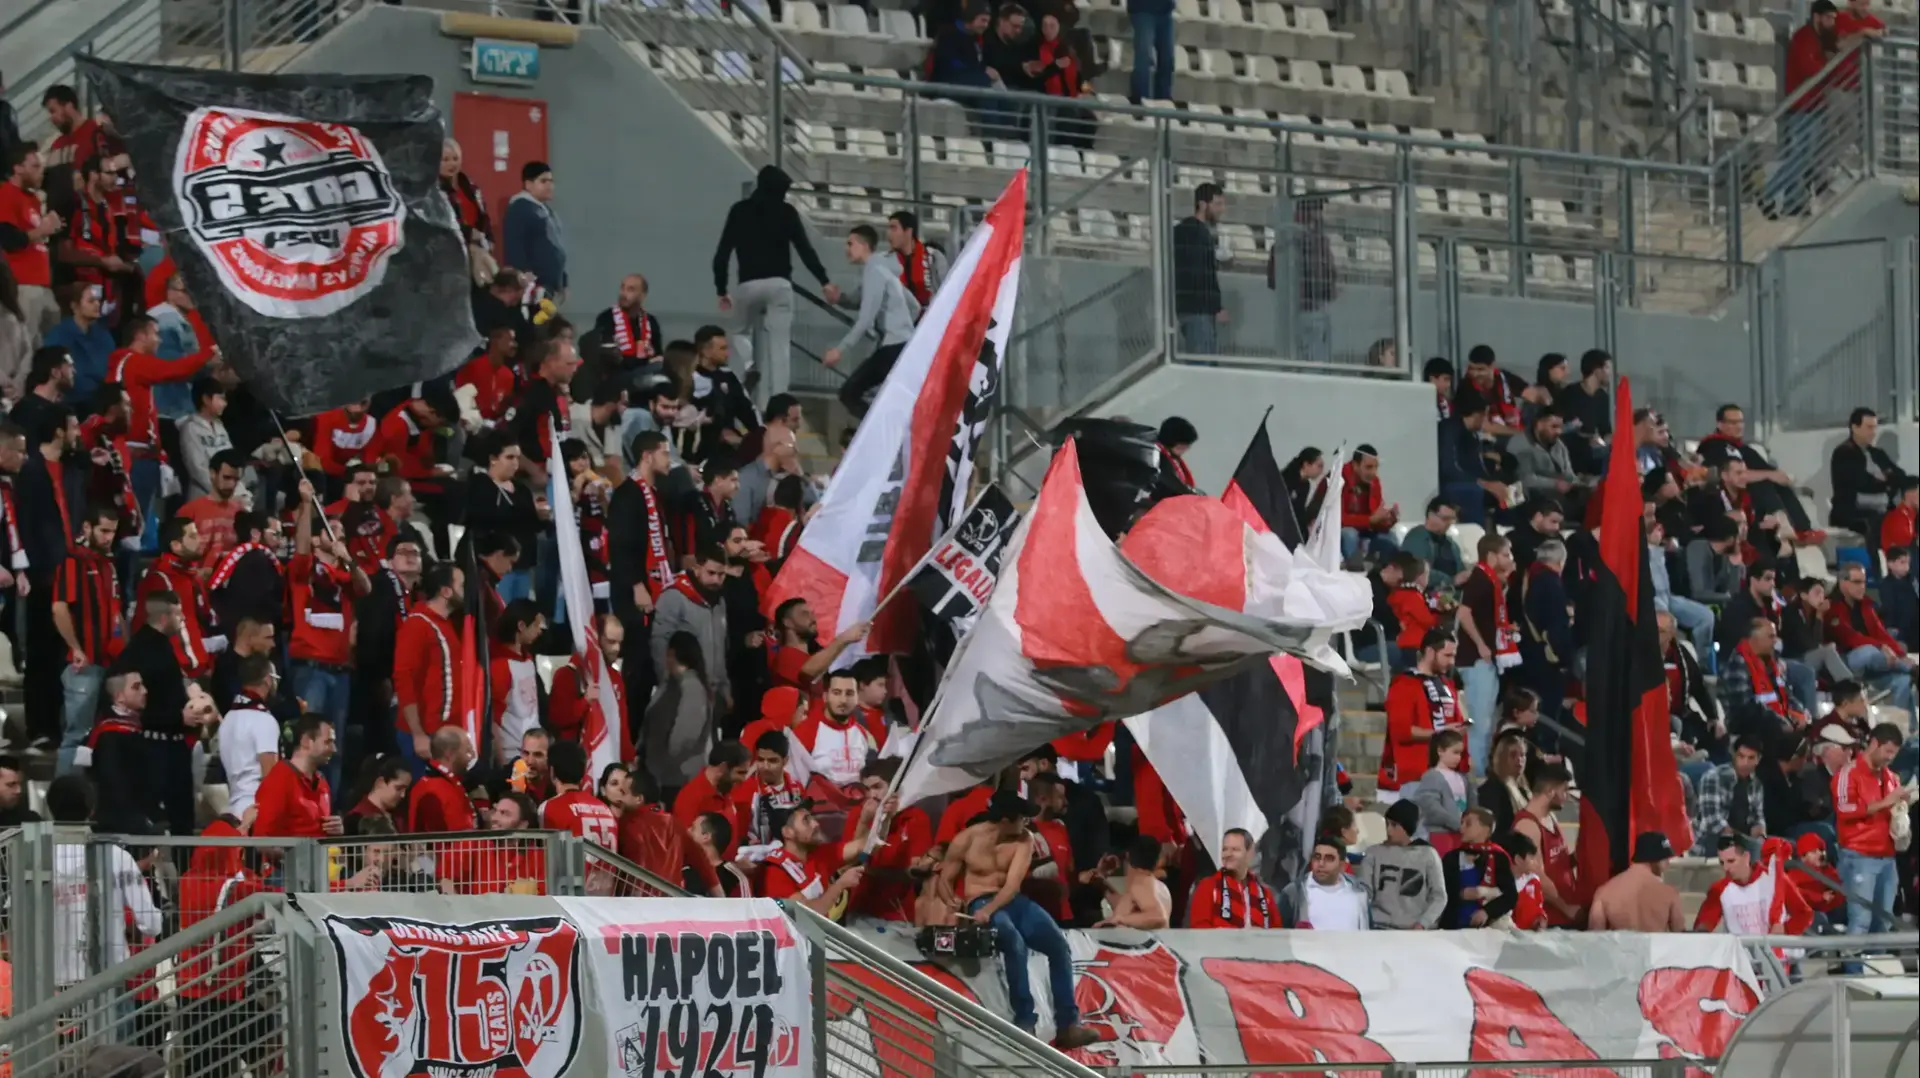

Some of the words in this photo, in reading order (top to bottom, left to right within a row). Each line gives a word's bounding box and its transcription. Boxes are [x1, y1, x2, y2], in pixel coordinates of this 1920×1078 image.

[934, 543, 993, 605] LEGALI
[581, 816, 617, 854] 55
[388, 920, 463, 945] ULTRAS
[461, 925, 506, 945] GATE
[500, 923, 519, 940] 5
[621, 931, 783, 1001] HAPOEL
[411, 946, 509, 1064] 15
[491, 991, 504, 1056] YEARS
[641, 999, 774, 1077] 1924
